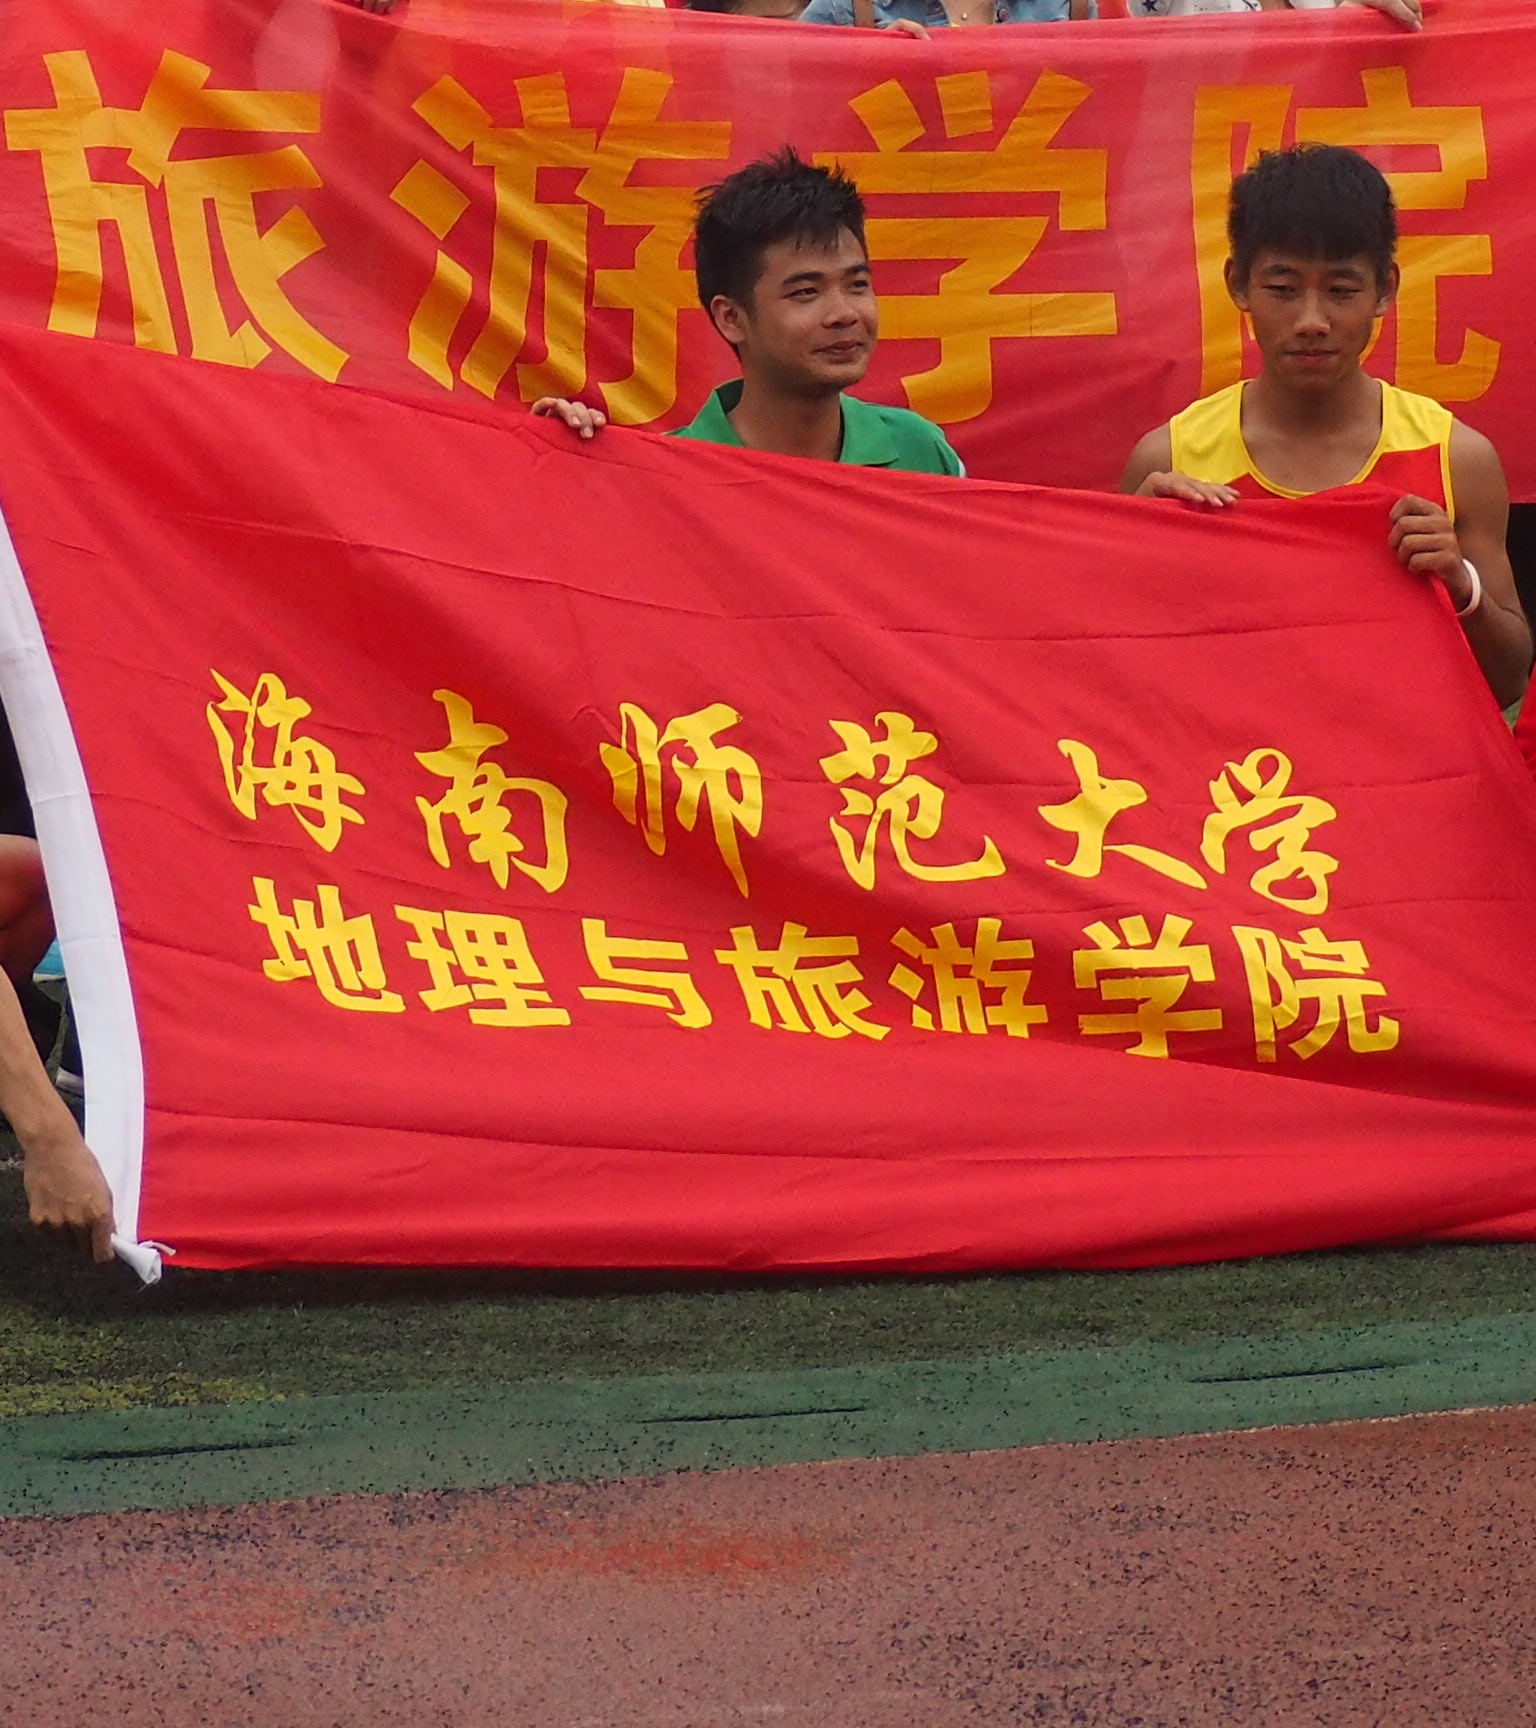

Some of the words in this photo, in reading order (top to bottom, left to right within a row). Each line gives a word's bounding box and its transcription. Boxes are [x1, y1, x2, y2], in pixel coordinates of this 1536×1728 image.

[206, 669, 1341, 915] 海南师范大学
[249, 876, 1401, 1063] 地理与旅游学院
